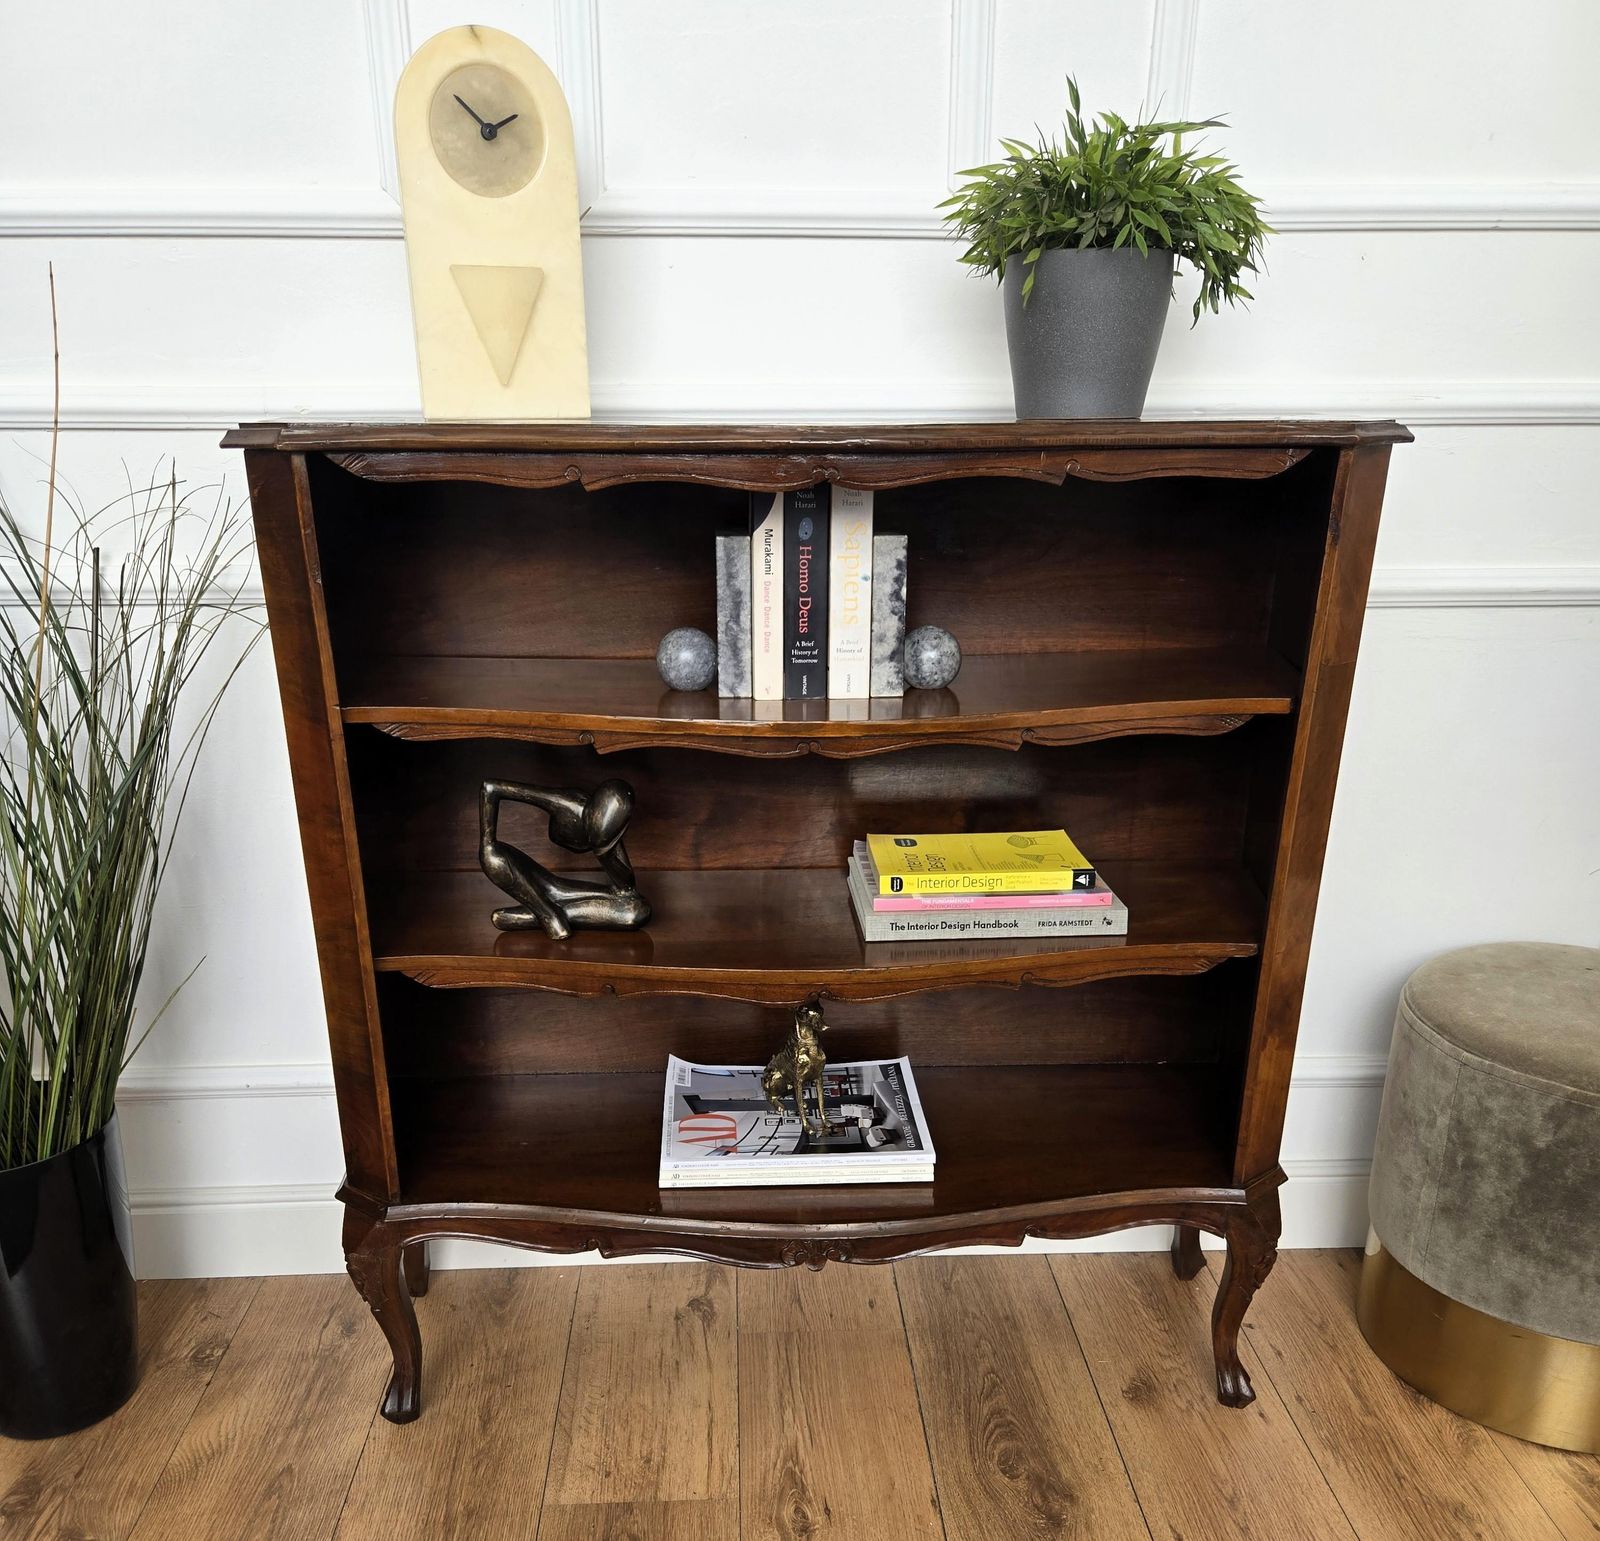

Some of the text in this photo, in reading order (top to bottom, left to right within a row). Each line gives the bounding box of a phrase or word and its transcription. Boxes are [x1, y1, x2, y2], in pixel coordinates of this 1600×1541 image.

[763, 528, 774, 653] Murakami Dance Dance Dance
[799, 546, 811, 633] Homo Deus
[837, 520, 867, 625] Sapiens
[917, 876, 960, 889] Interior
[962, 876, 1003, 890] Design
[890, 920, 1019, 933] The Interior Design Handbook
[888, 1065, 916, 1148] GRANDE BELLEZZA ITALIANA
